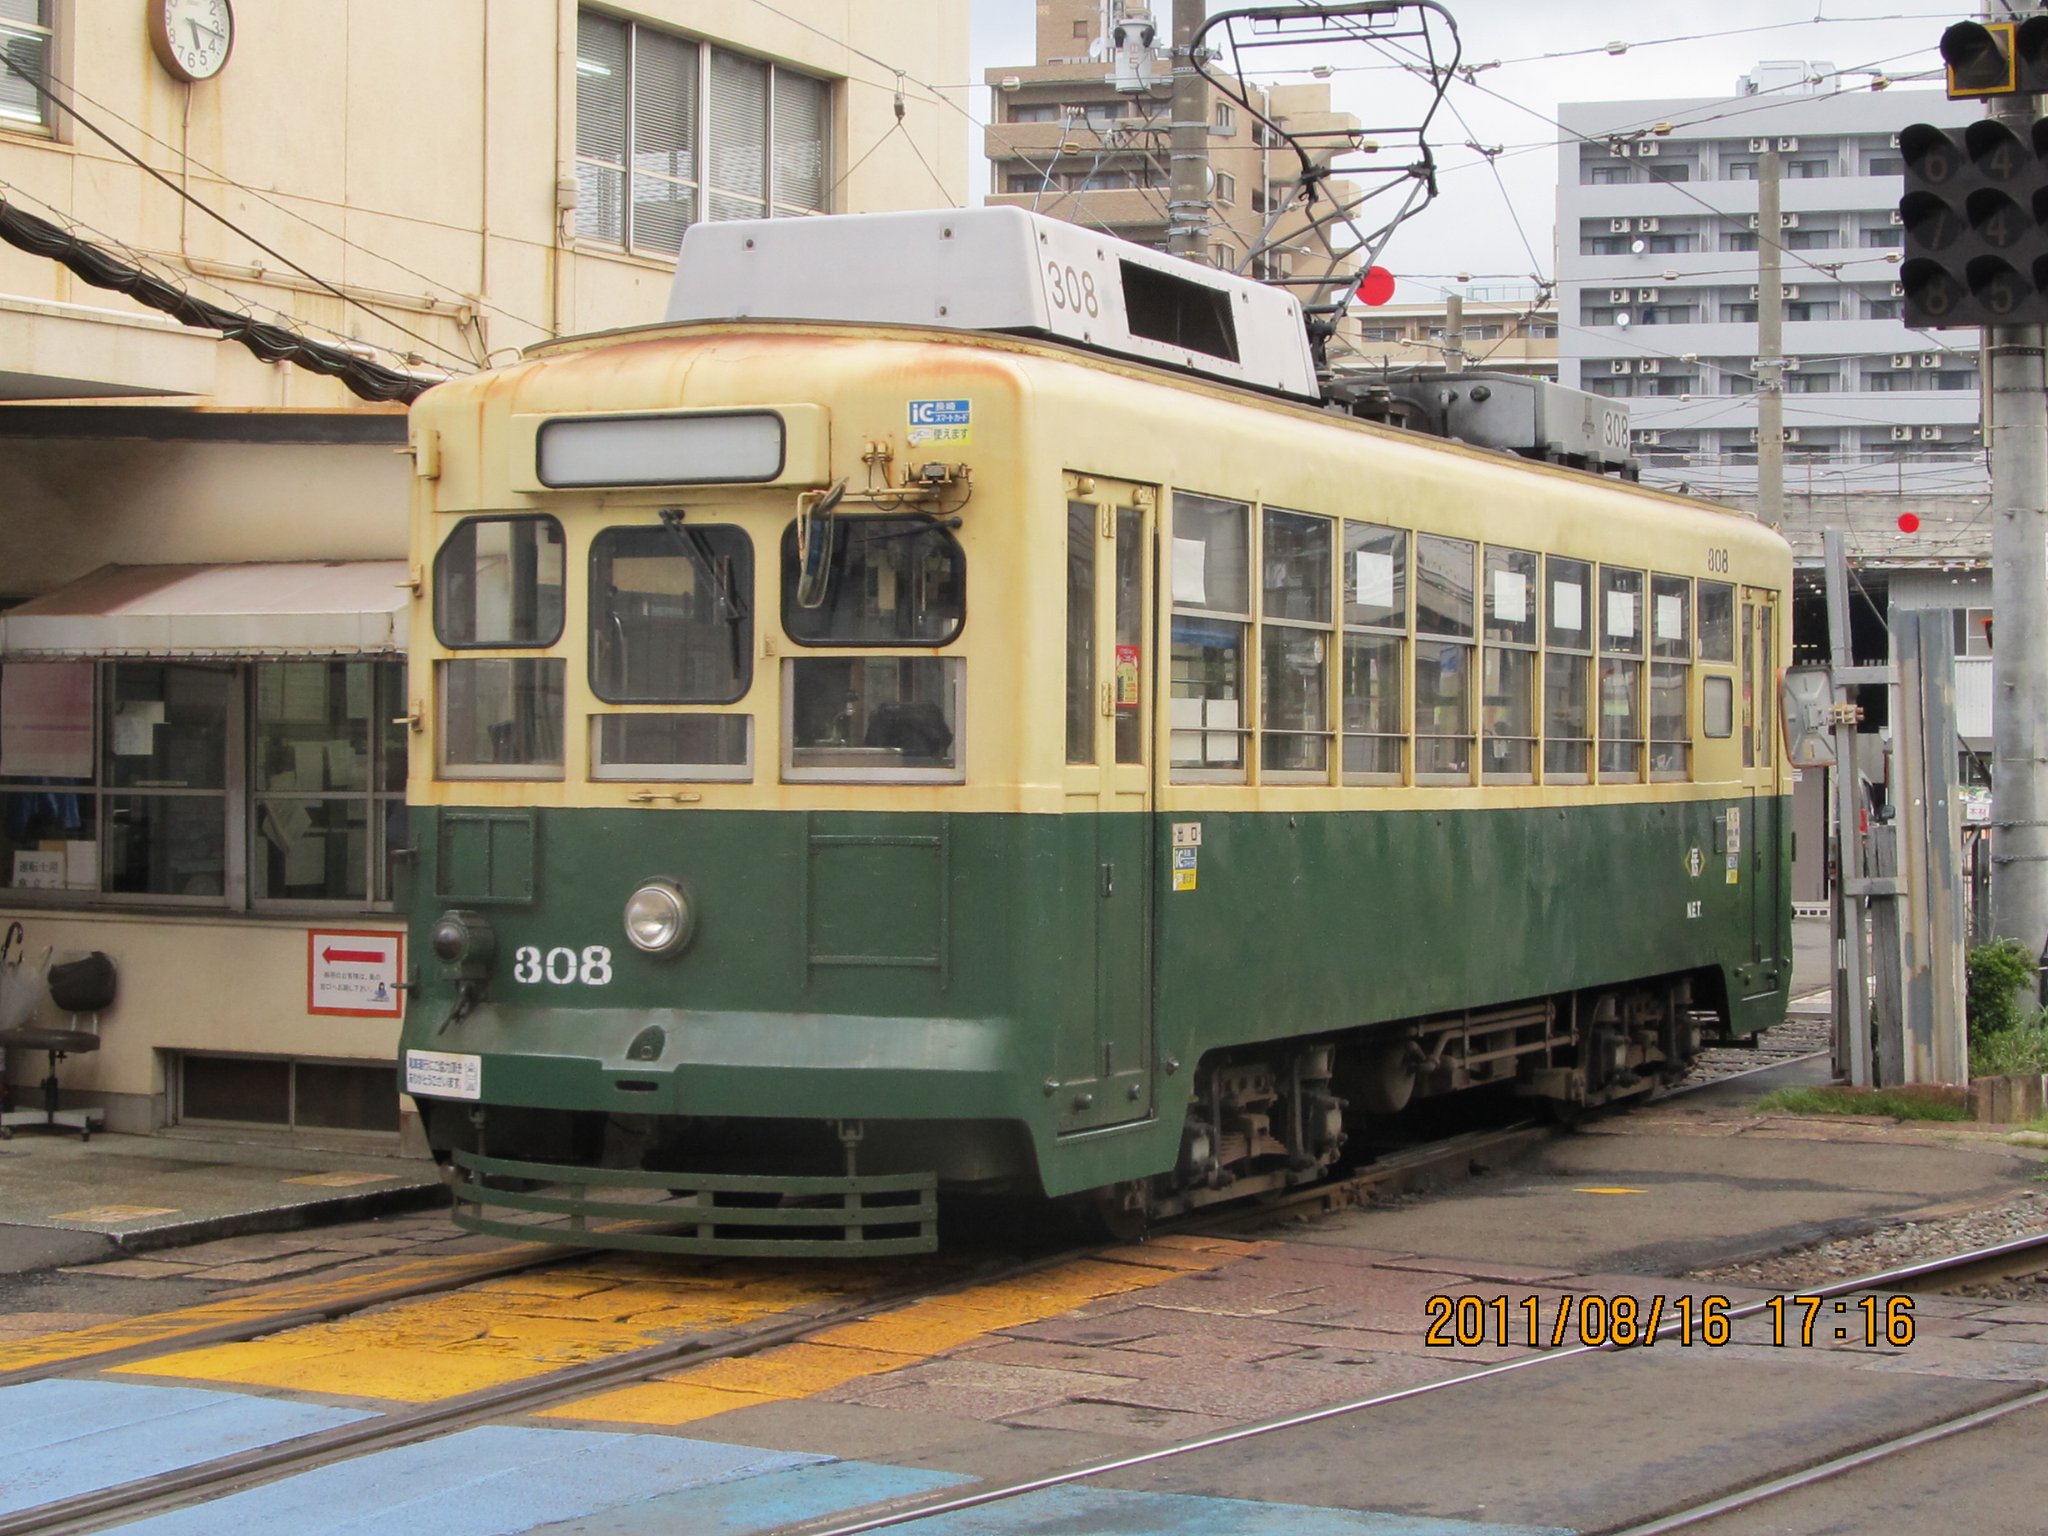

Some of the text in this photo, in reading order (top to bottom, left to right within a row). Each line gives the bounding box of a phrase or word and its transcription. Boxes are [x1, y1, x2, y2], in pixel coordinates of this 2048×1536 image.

[187, 52, 196, 68] 6
[1047, 260, 1099, 319] 308
[1604, 411, 1629, 449] 308
[1707, 547, 1729, 574] 308
[513, 945, 613, 986] 308
